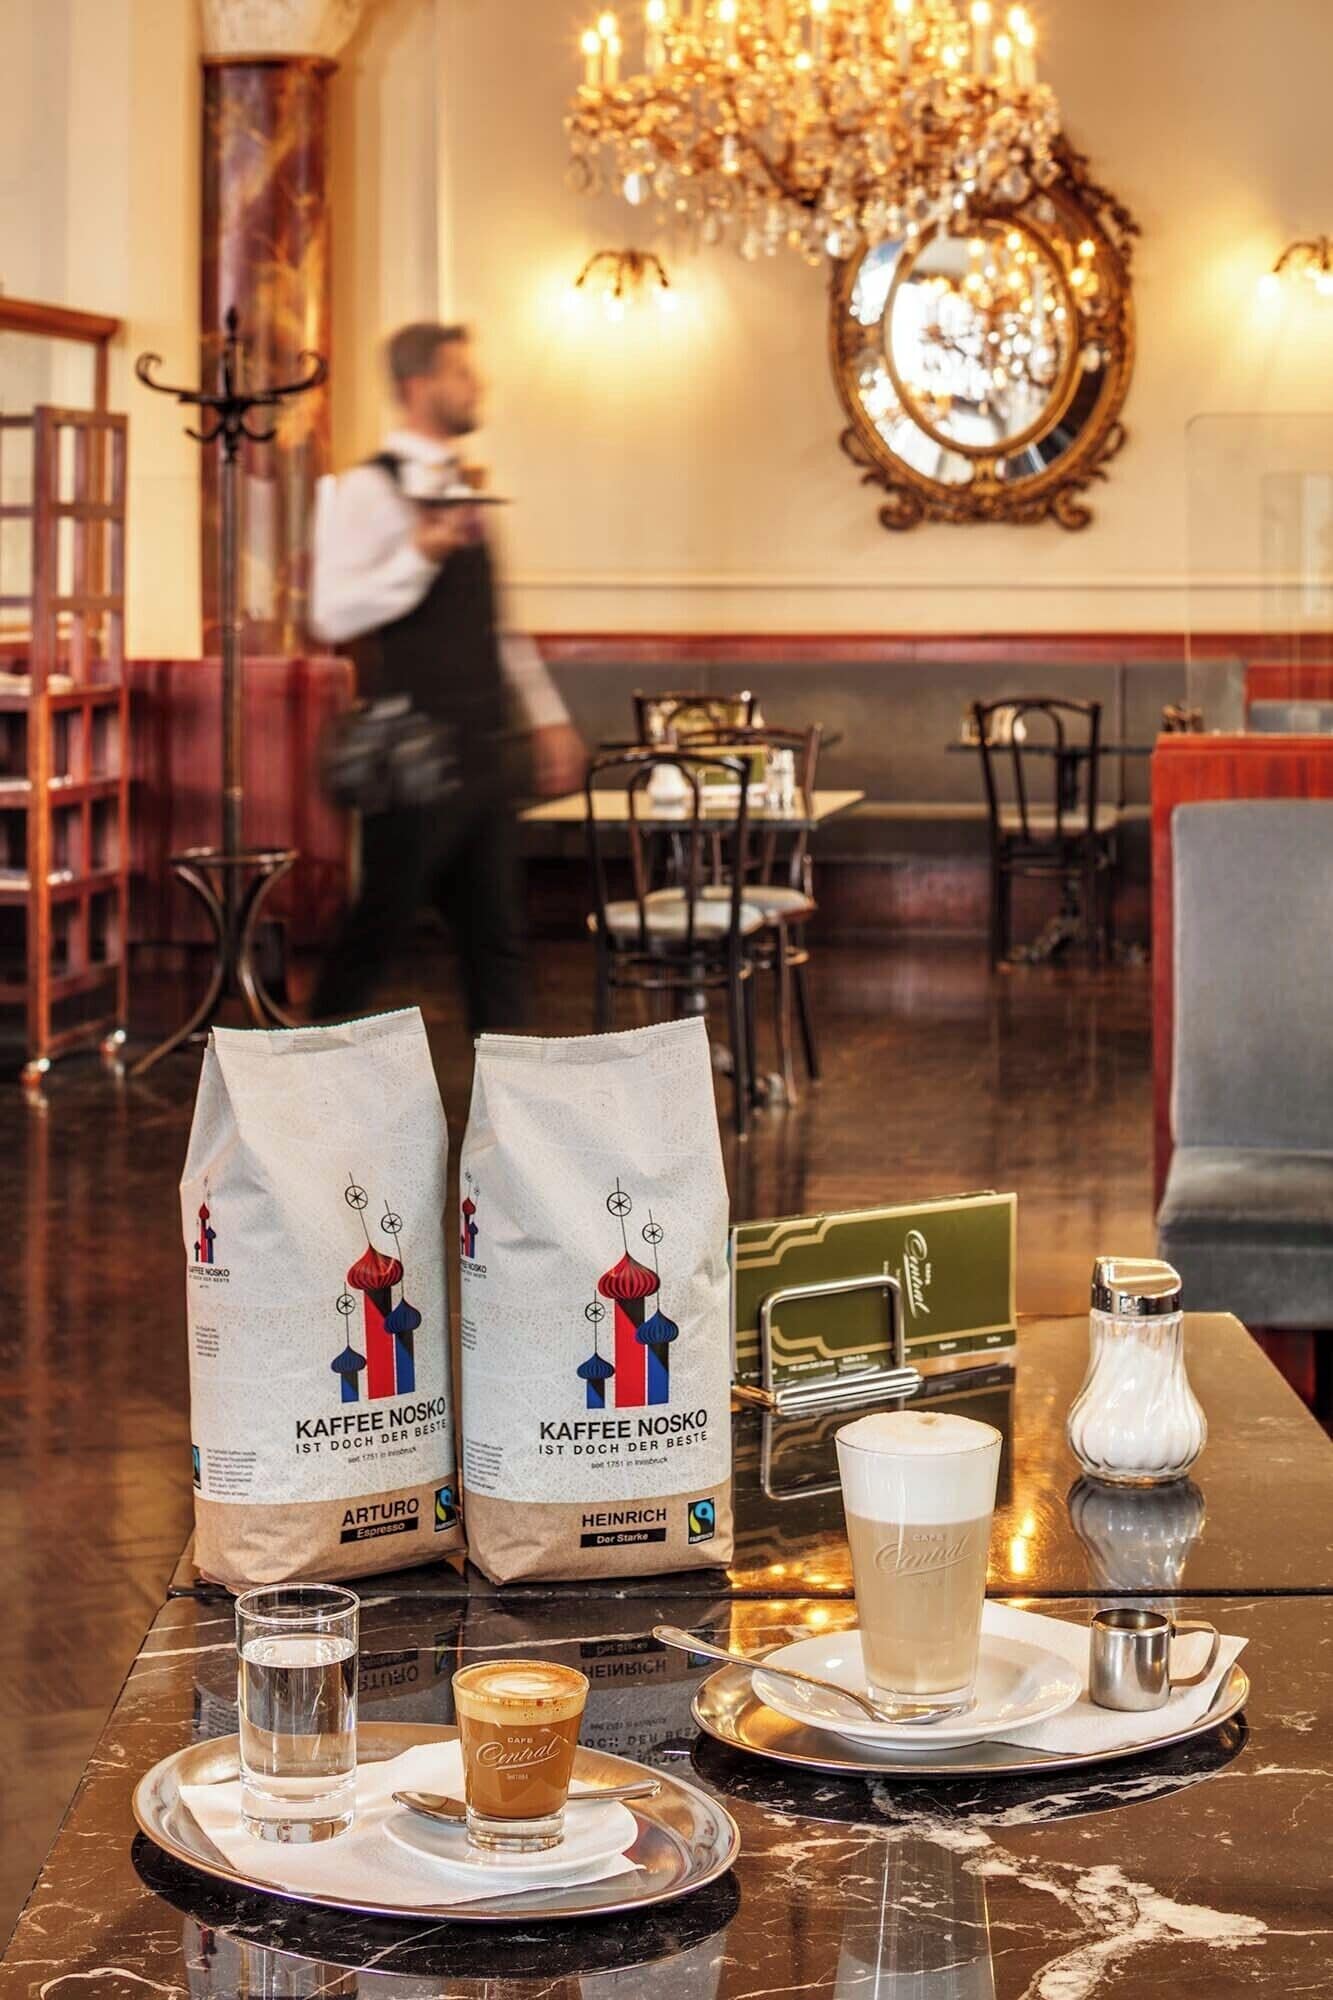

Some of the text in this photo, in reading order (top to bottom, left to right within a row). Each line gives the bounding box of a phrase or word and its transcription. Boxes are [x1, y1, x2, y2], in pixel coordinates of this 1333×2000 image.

[903, 1229, 931, 1318] Central
[296, 1396, 446, 1439] KAFFEE NOSKO
[539, 1408, 708, 1441] KAFFEE NOSKO
[295, 1419, 447, 1454] IST DOCH DER BESTE
[538, 1430, 708, 1455] IST DOCH DER BESTE
[606, 1460, 624, 1468] 1751
[341, 1498, 420, 1527] ARTURO
[582, 1508, 667, 1528] HEINRICH
[356, 1522, 405, 1539] Espresso
[596, 1532, 649, 1544] Der Starke
[873, 1531, 971, 1576] Central
[476, 1735, 561, 1770] Central
